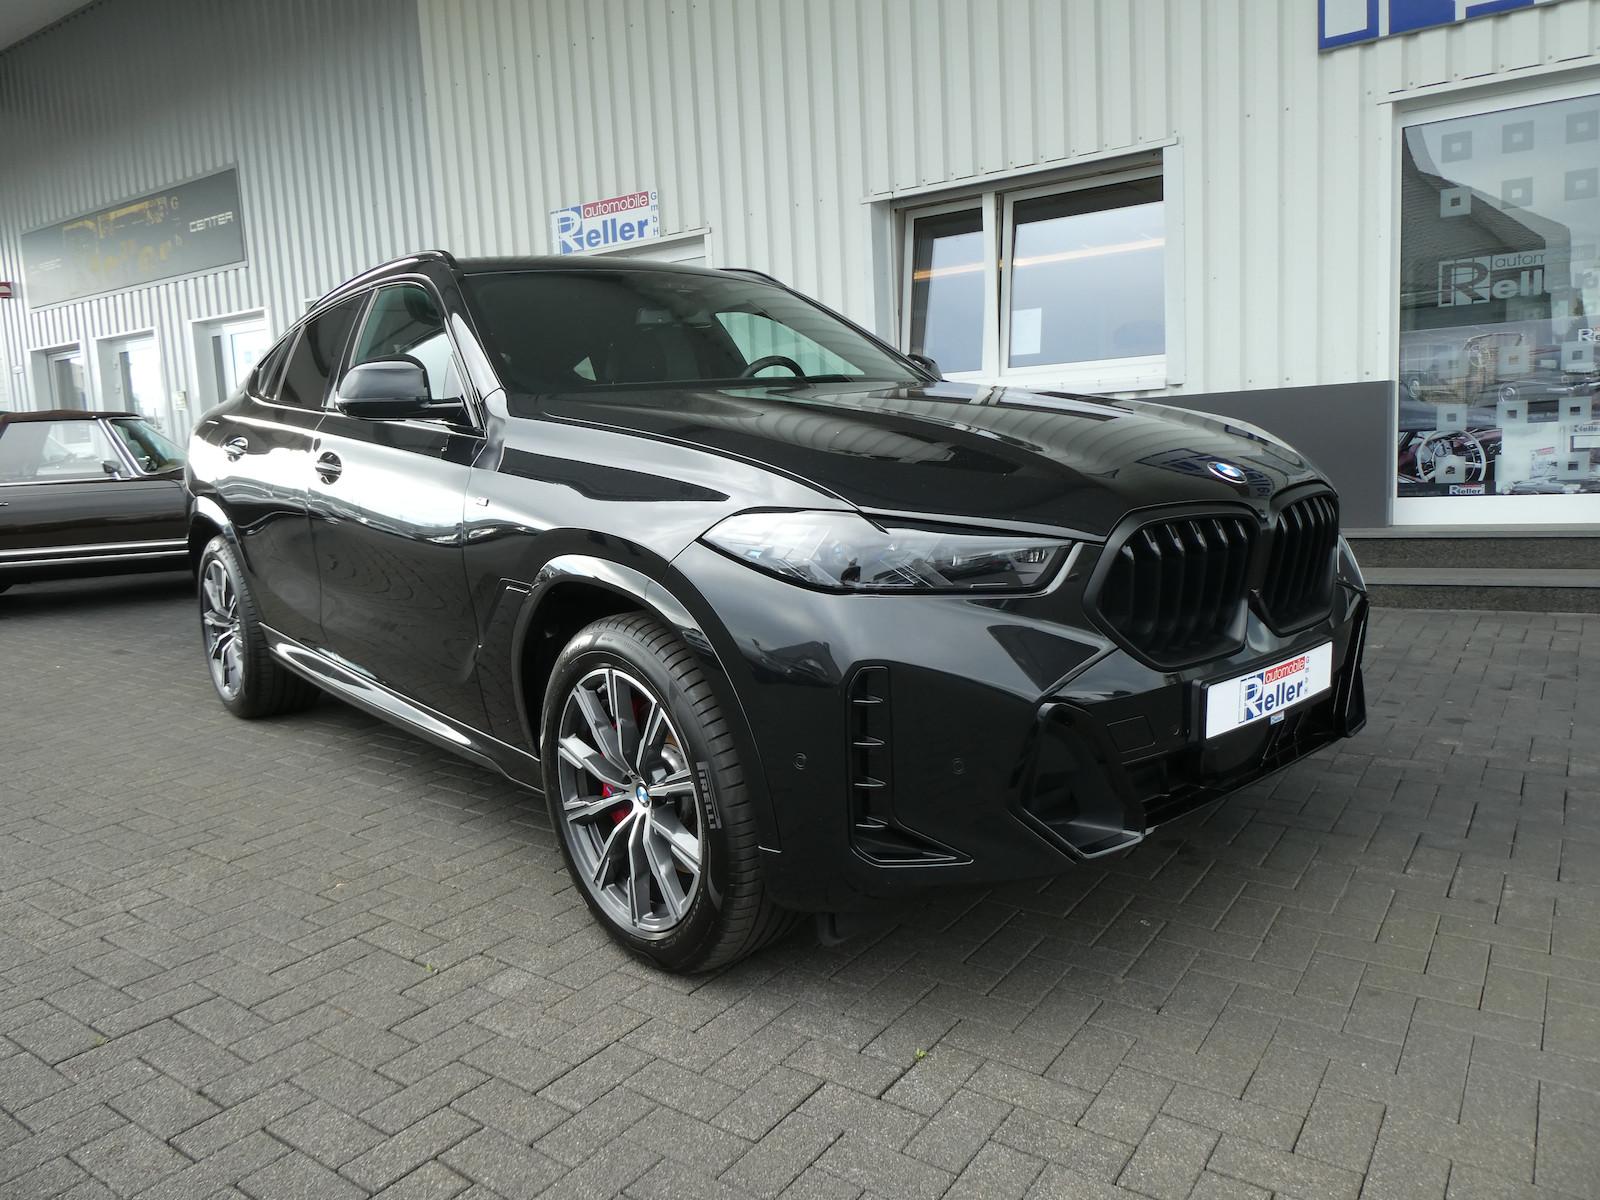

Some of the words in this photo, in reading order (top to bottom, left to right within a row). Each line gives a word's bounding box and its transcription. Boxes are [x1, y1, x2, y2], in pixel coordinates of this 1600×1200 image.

[189, 211, 233, 233] CENTER
[584, 194, 648, 218] automobile
[550, 206, 648, 256] Reller
[1265, 658, 1305, 683] automobile
[1238, 672, 1303, 724] Reller
[696, 761, 722, 829] PIRELLI
